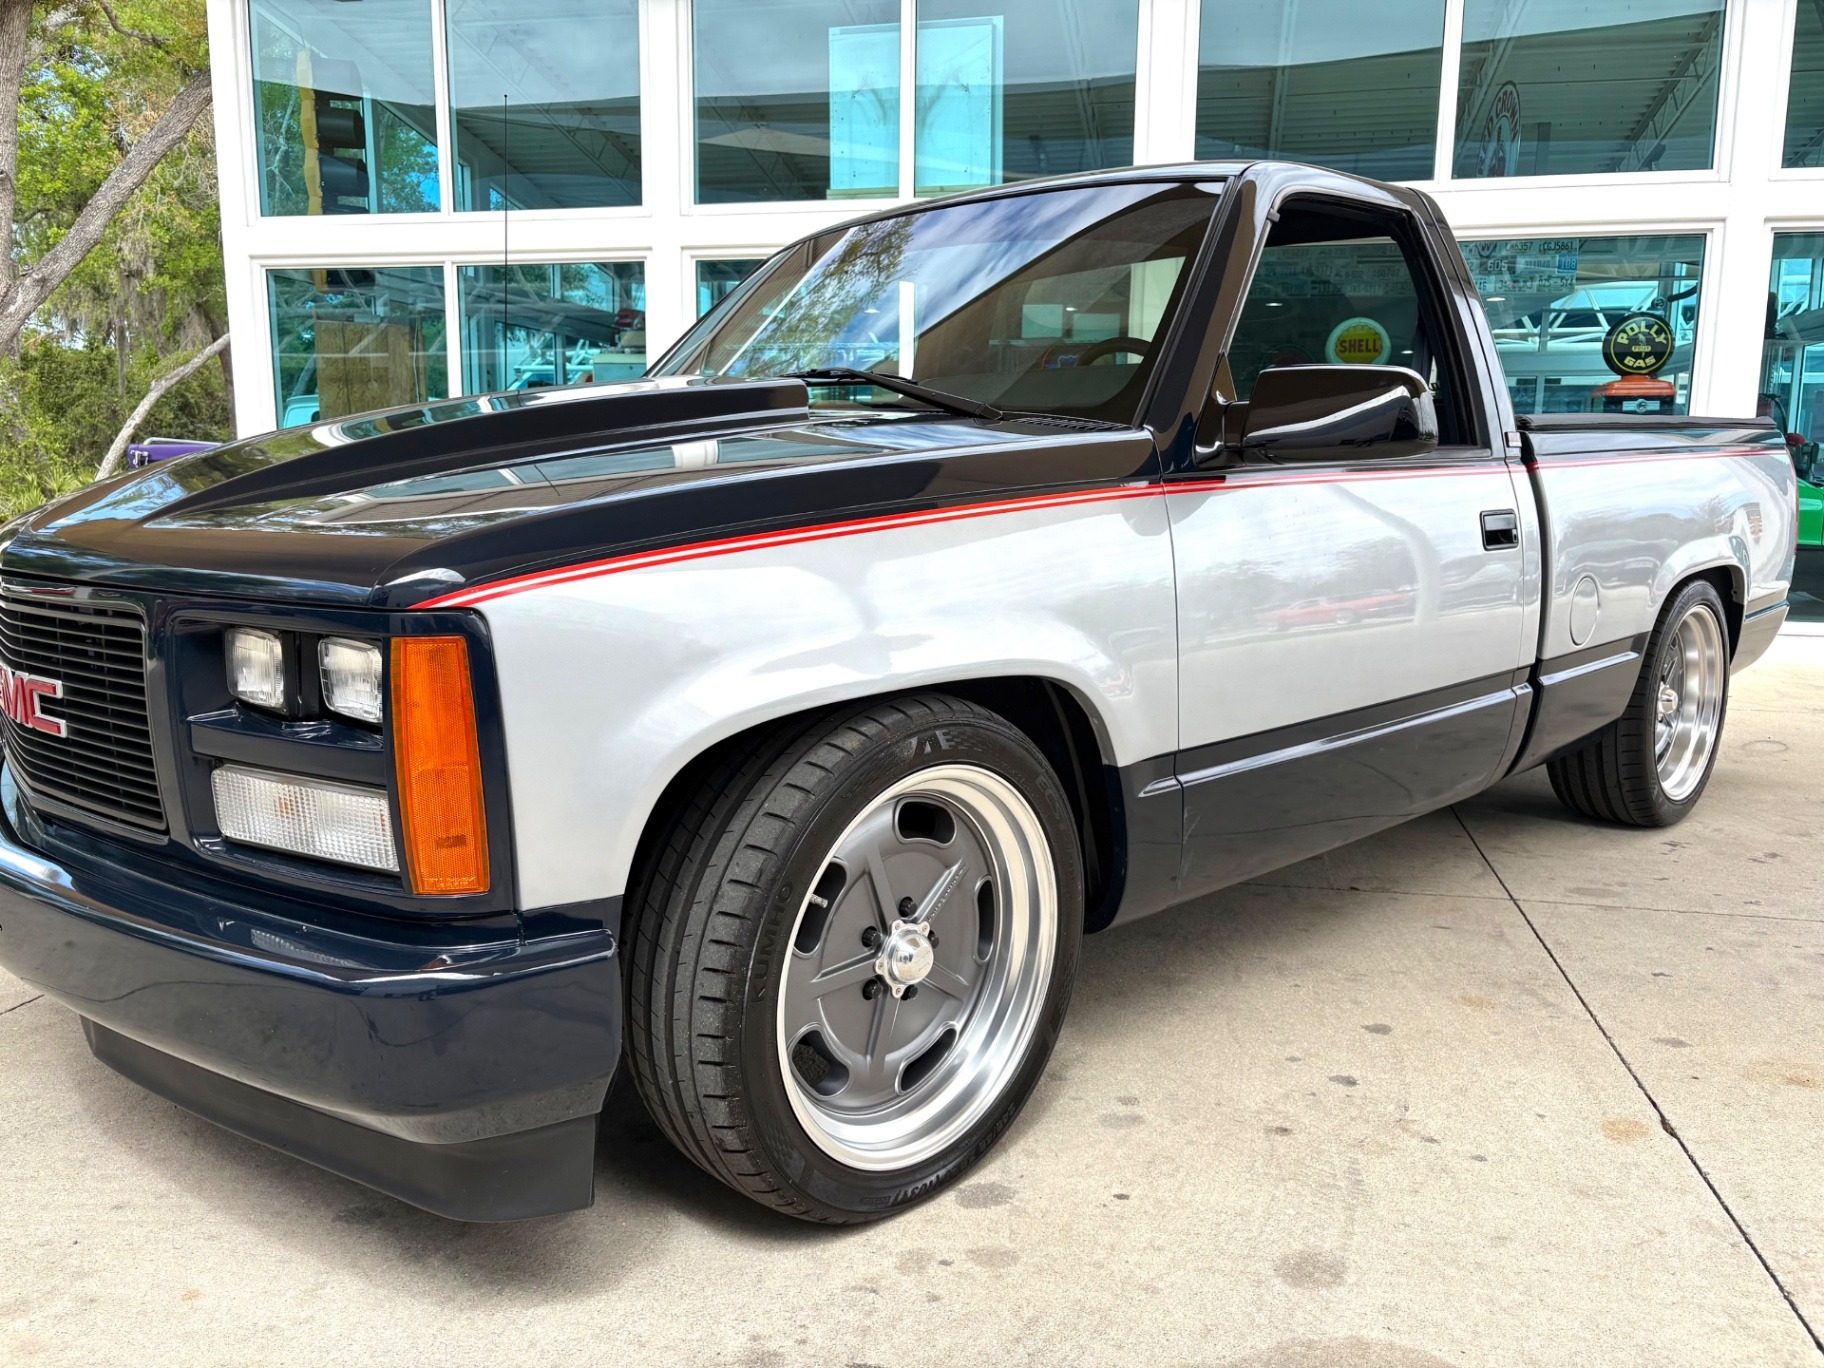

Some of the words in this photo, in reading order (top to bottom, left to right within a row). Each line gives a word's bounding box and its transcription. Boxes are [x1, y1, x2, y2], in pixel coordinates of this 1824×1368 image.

[1495, 89, 1519, 143] CROWN
[1338, 338, 1379, 353] SHELL
[1616, 321, 1667, 345] POLLY
[1623, 355, 1656, 368] GAS
[0, 664, 68, 738] MC
[751, 881, 794, 1003] KUMHO
